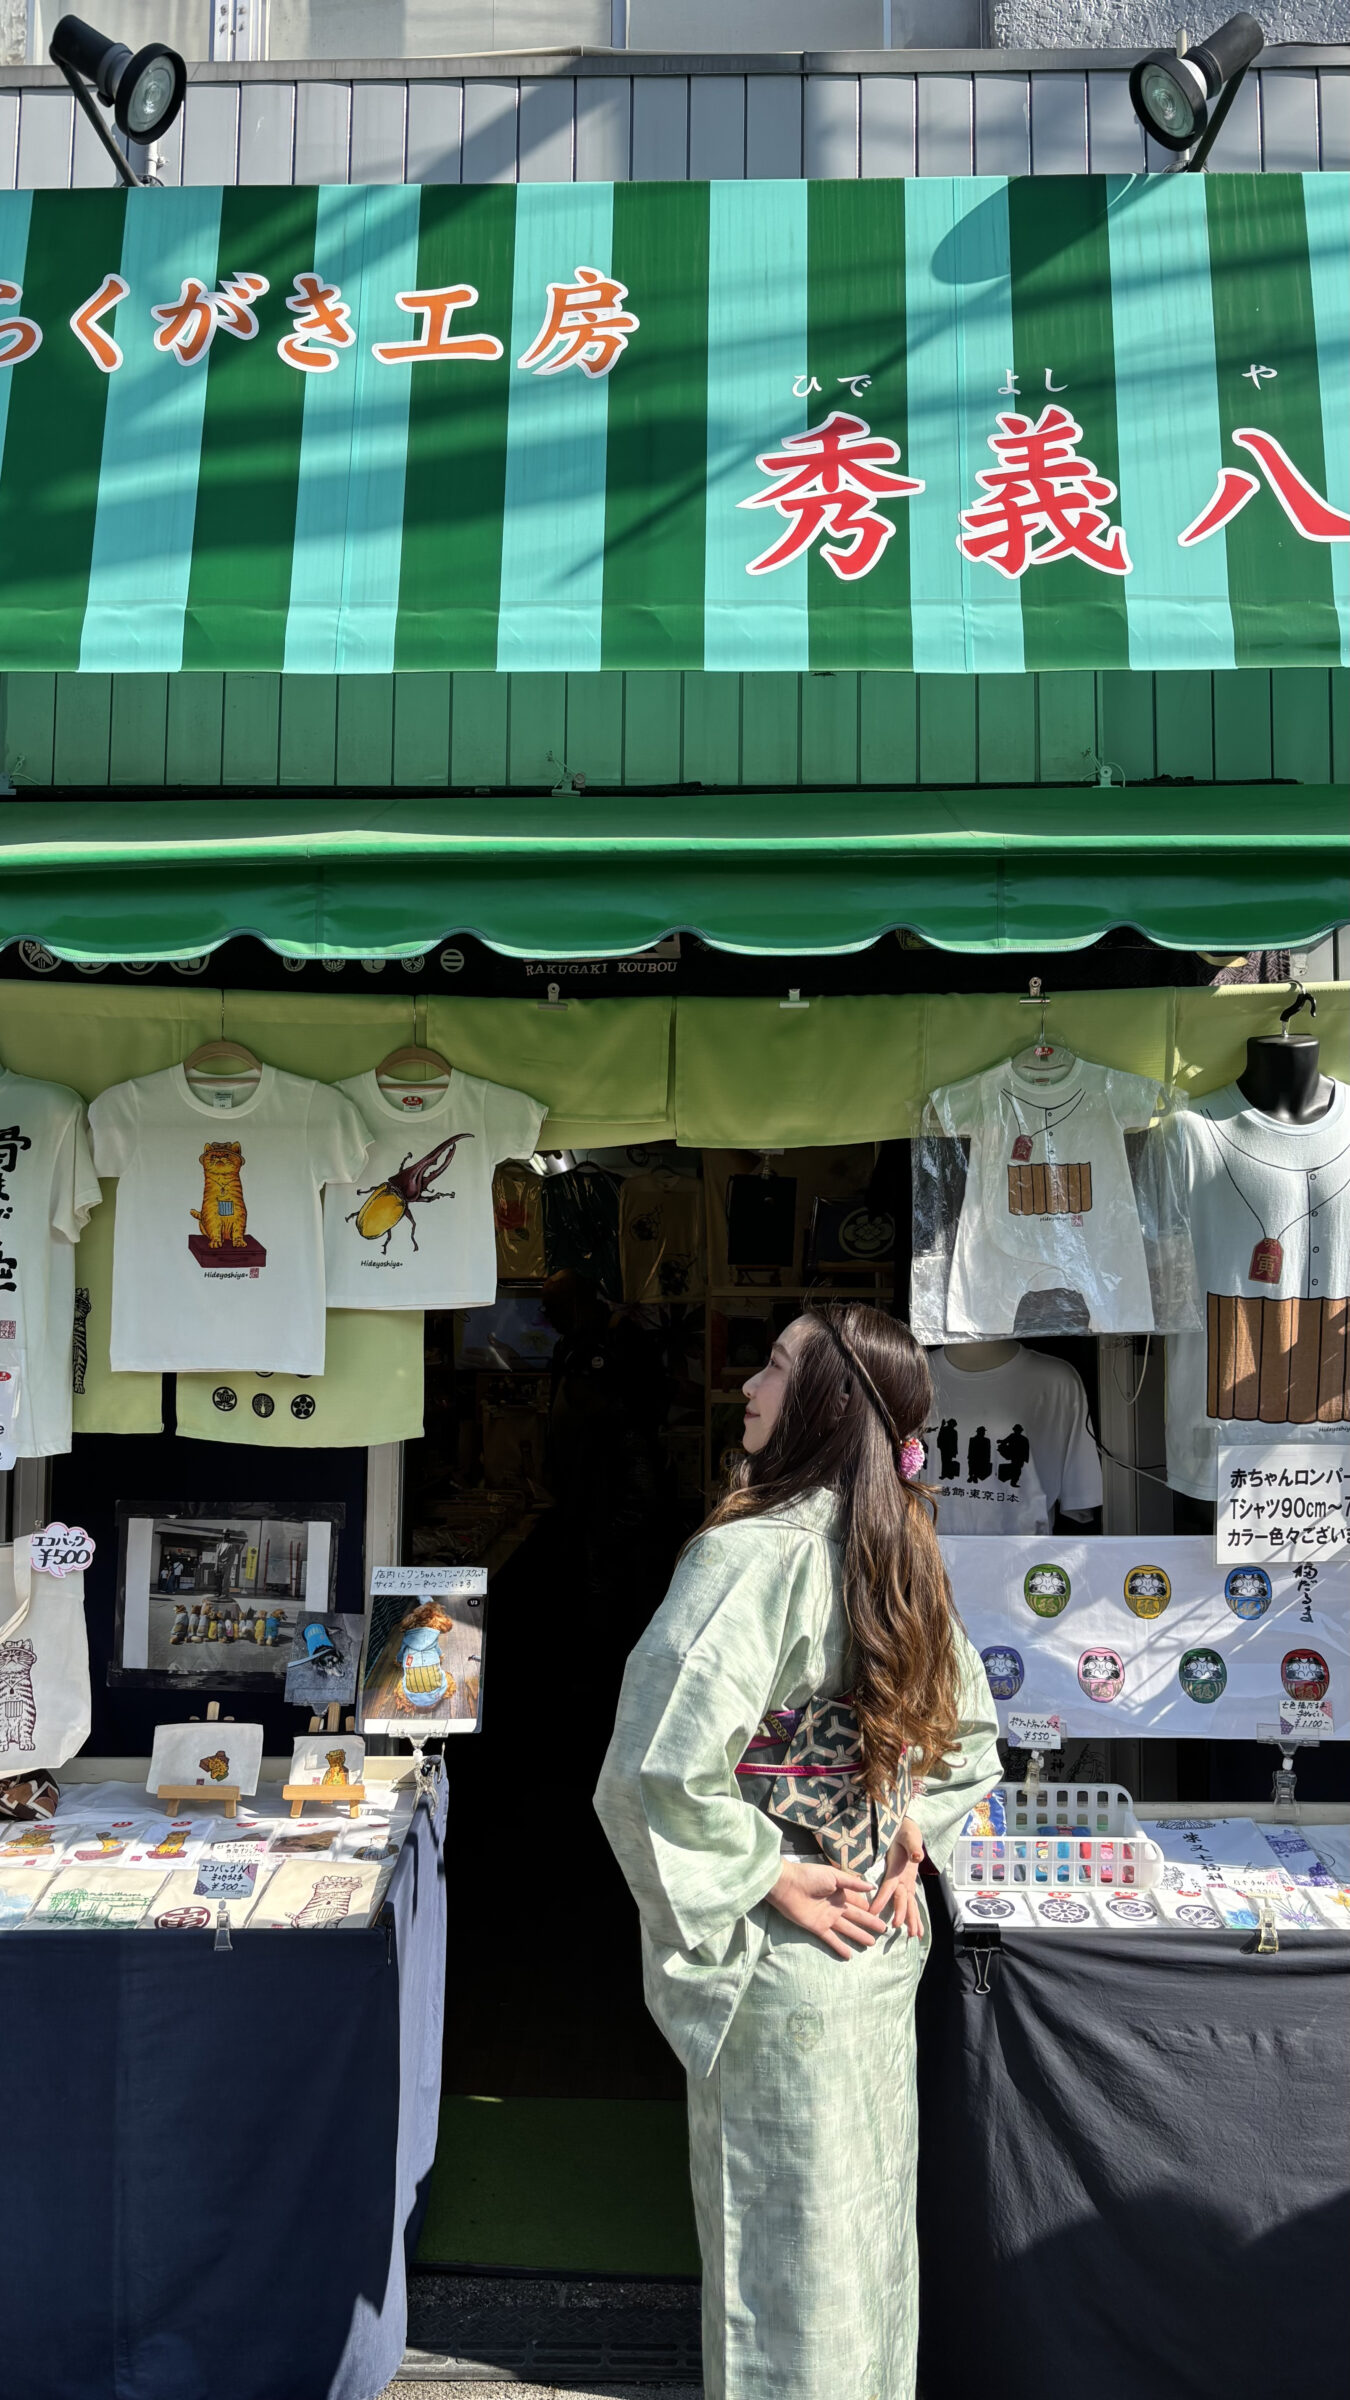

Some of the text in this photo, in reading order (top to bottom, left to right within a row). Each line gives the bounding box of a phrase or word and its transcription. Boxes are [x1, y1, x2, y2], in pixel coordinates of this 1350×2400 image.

[526, 961, 678, 976] RAKUGAKI KOUBOU
[1255, 1253, 1278, 1278] 寅
[32, 1531, 86, 1548] エコバッグ
[37, 1548, 91, 1568] ¥500
